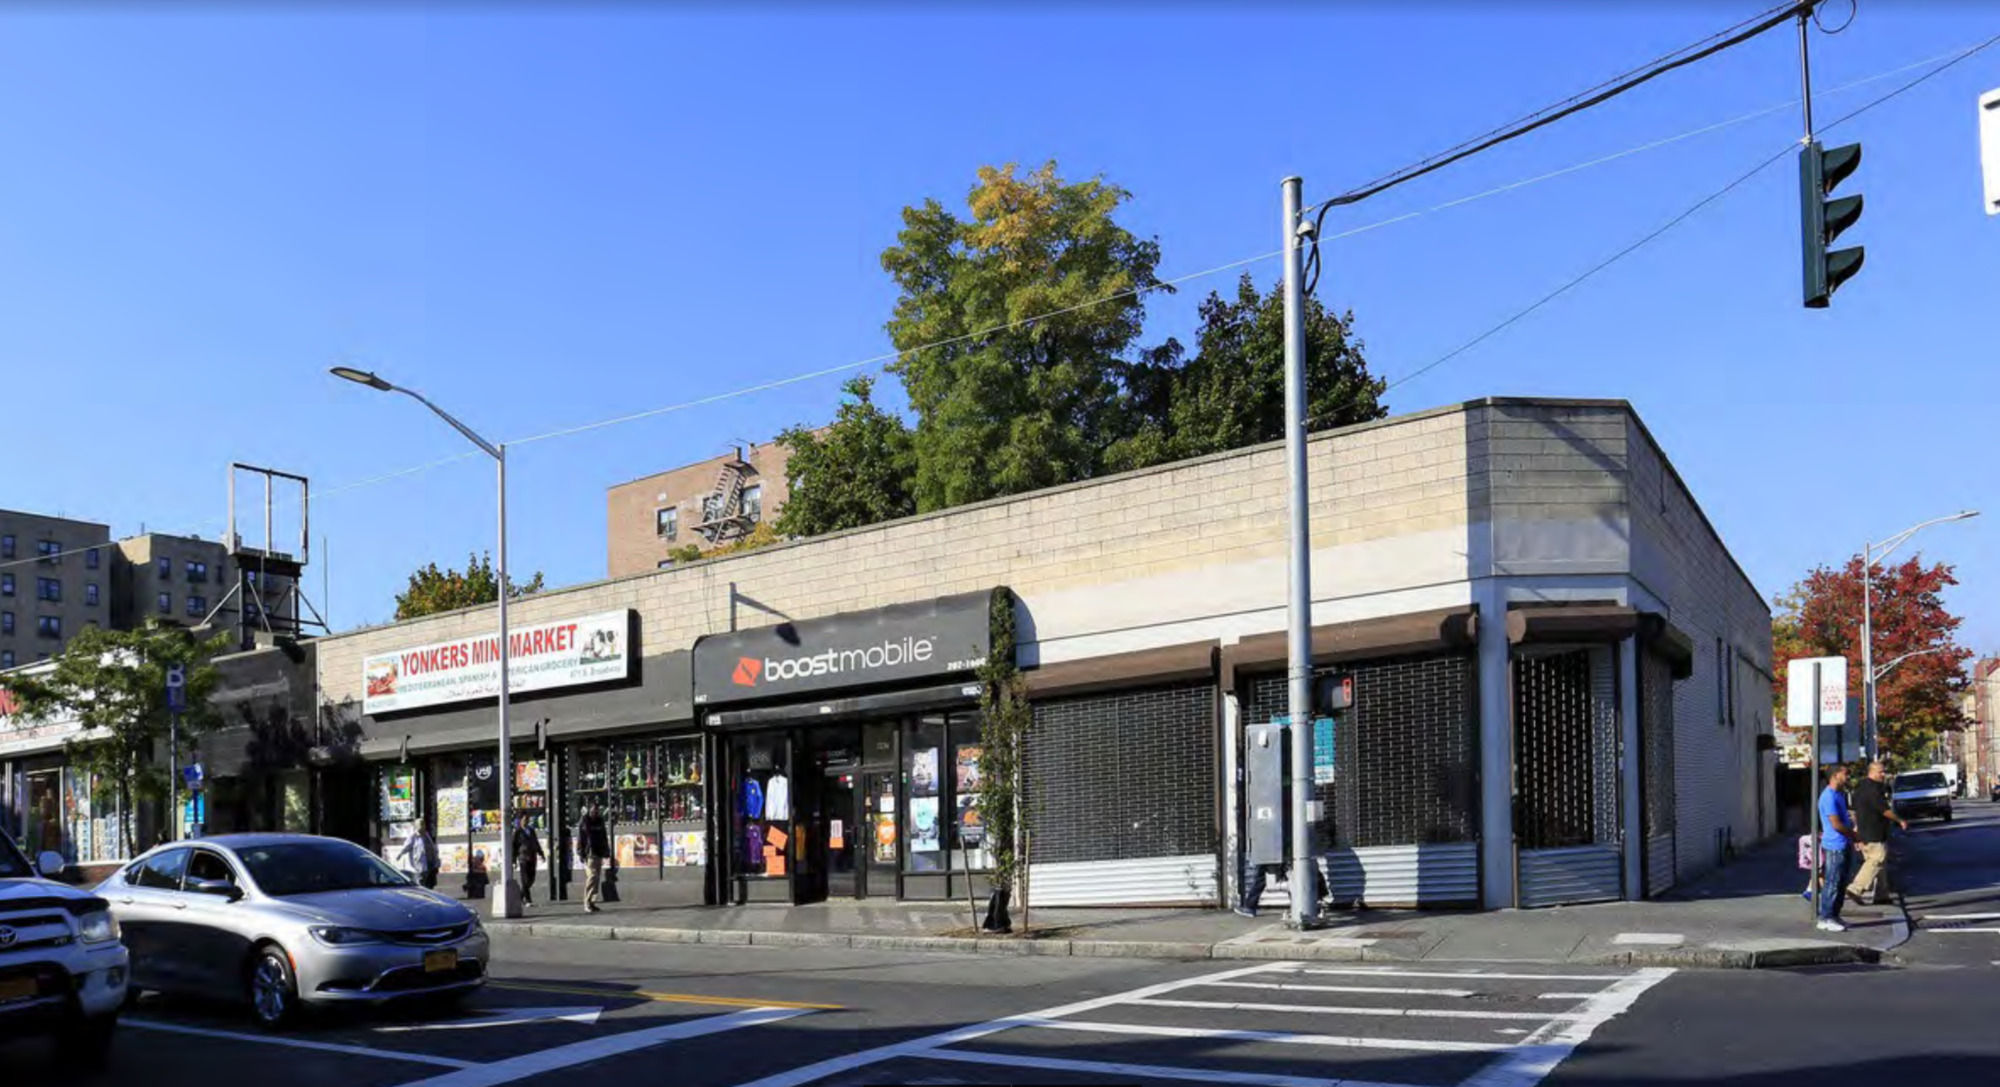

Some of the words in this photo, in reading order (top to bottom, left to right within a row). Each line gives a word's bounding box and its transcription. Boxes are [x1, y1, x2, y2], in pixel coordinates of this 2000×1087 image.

[401, 643, 468, 677] YONKERS
[472, 637, 501, 665] MIN
[509, 623, 577, 659] MARKET
[458, 672, 490, 684] SPANISH
[540, 657, 578, 671] GROCERY
